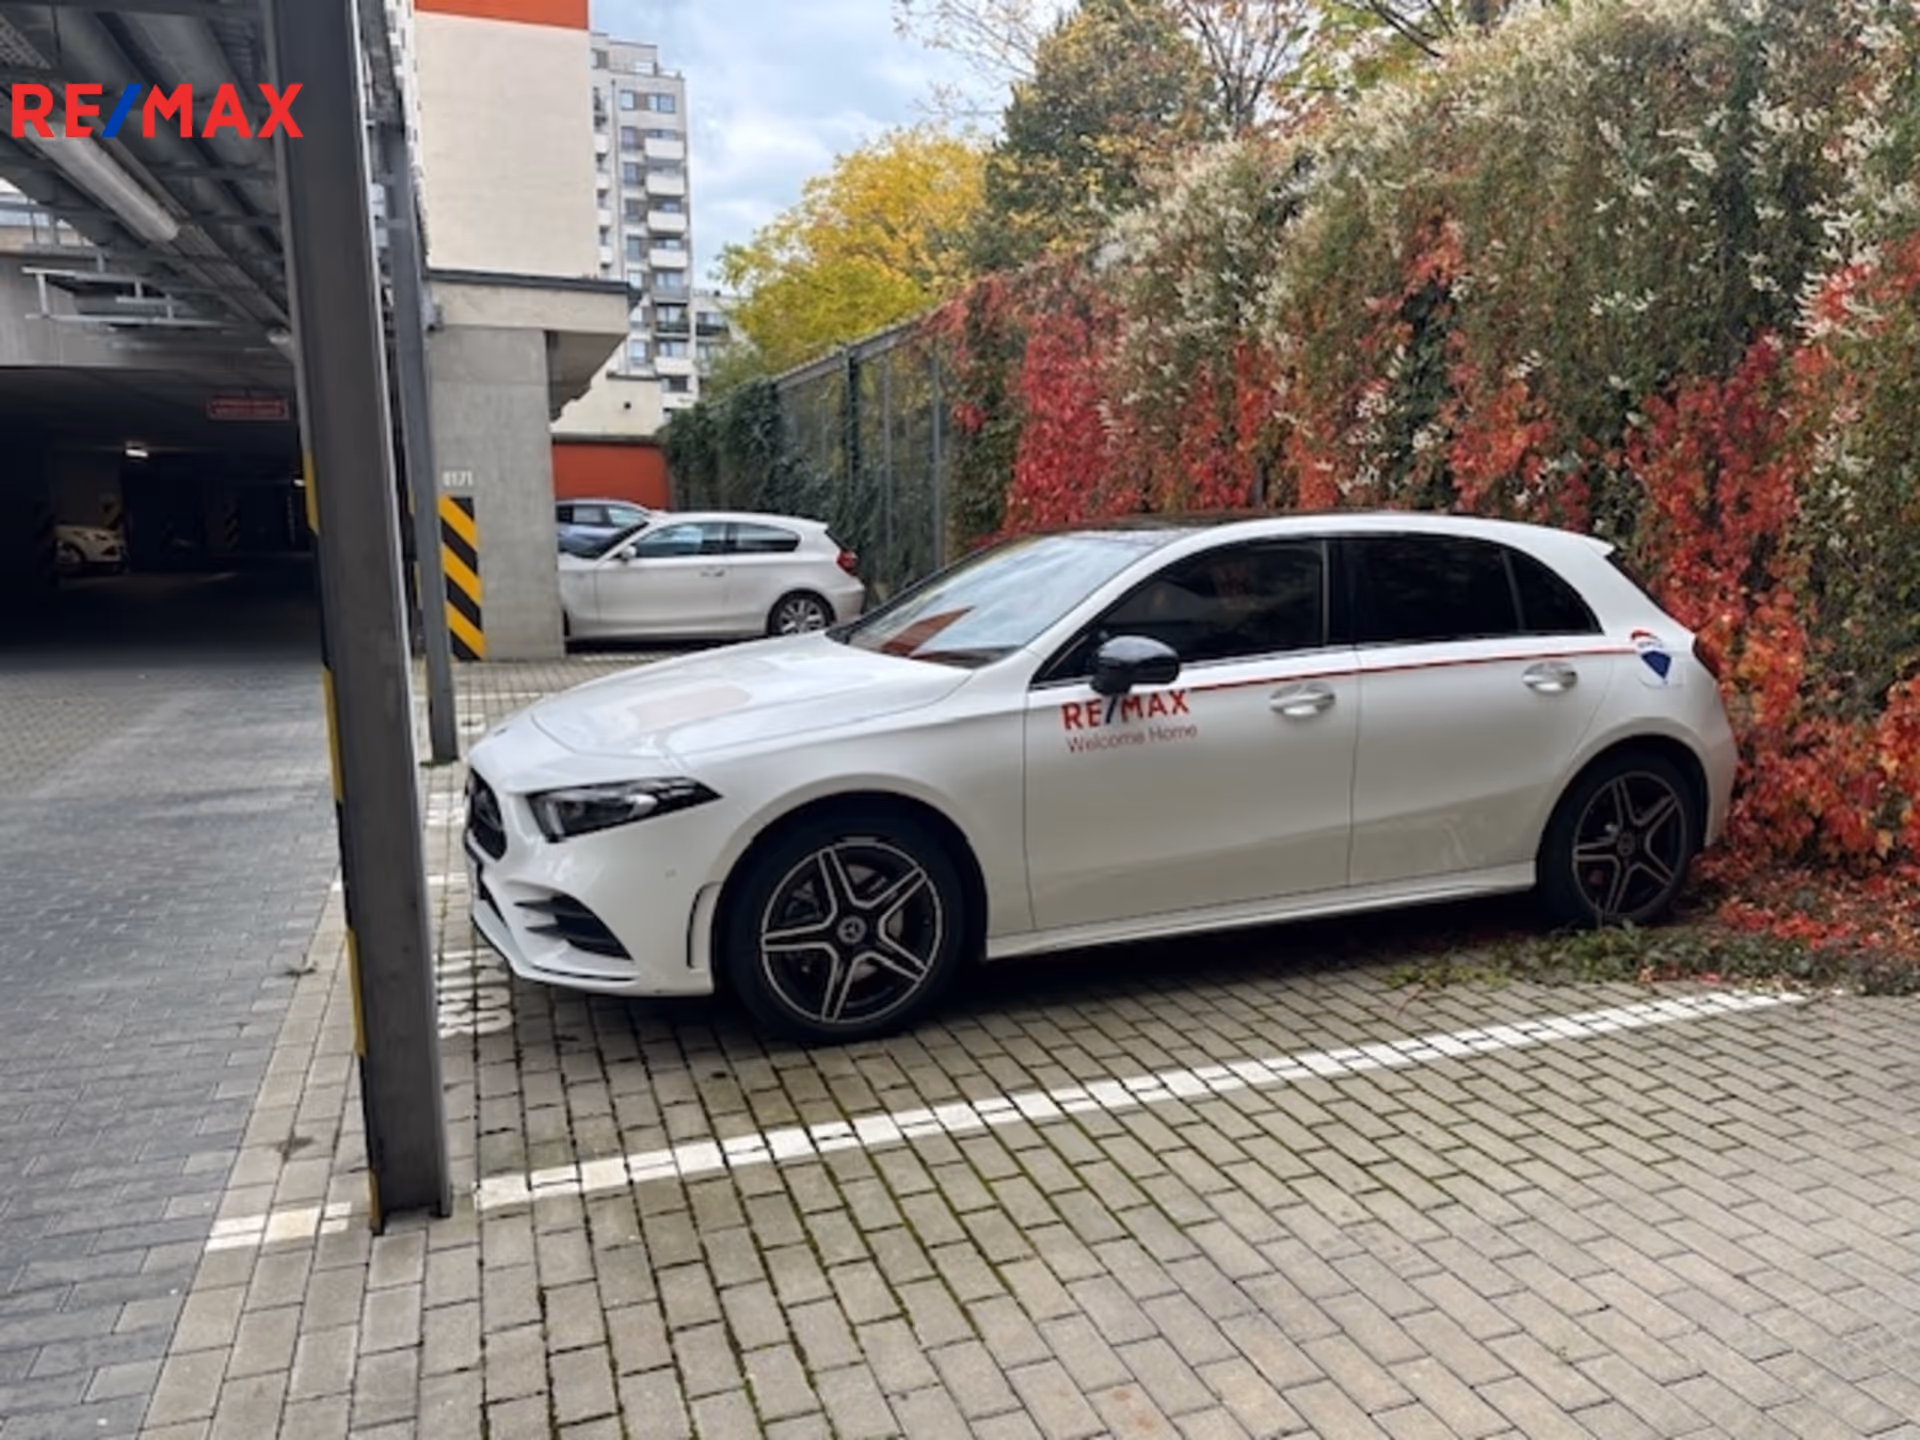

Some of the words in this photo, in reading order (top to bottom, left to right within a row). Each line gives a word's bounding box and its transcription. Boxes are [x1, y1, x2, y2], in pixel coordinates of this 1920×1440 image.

[1060, 689, 1190, 730] RE/MAX
[1066, 730, 1146, 753] Welcome
[1149, 724, 1199, 744] Home
